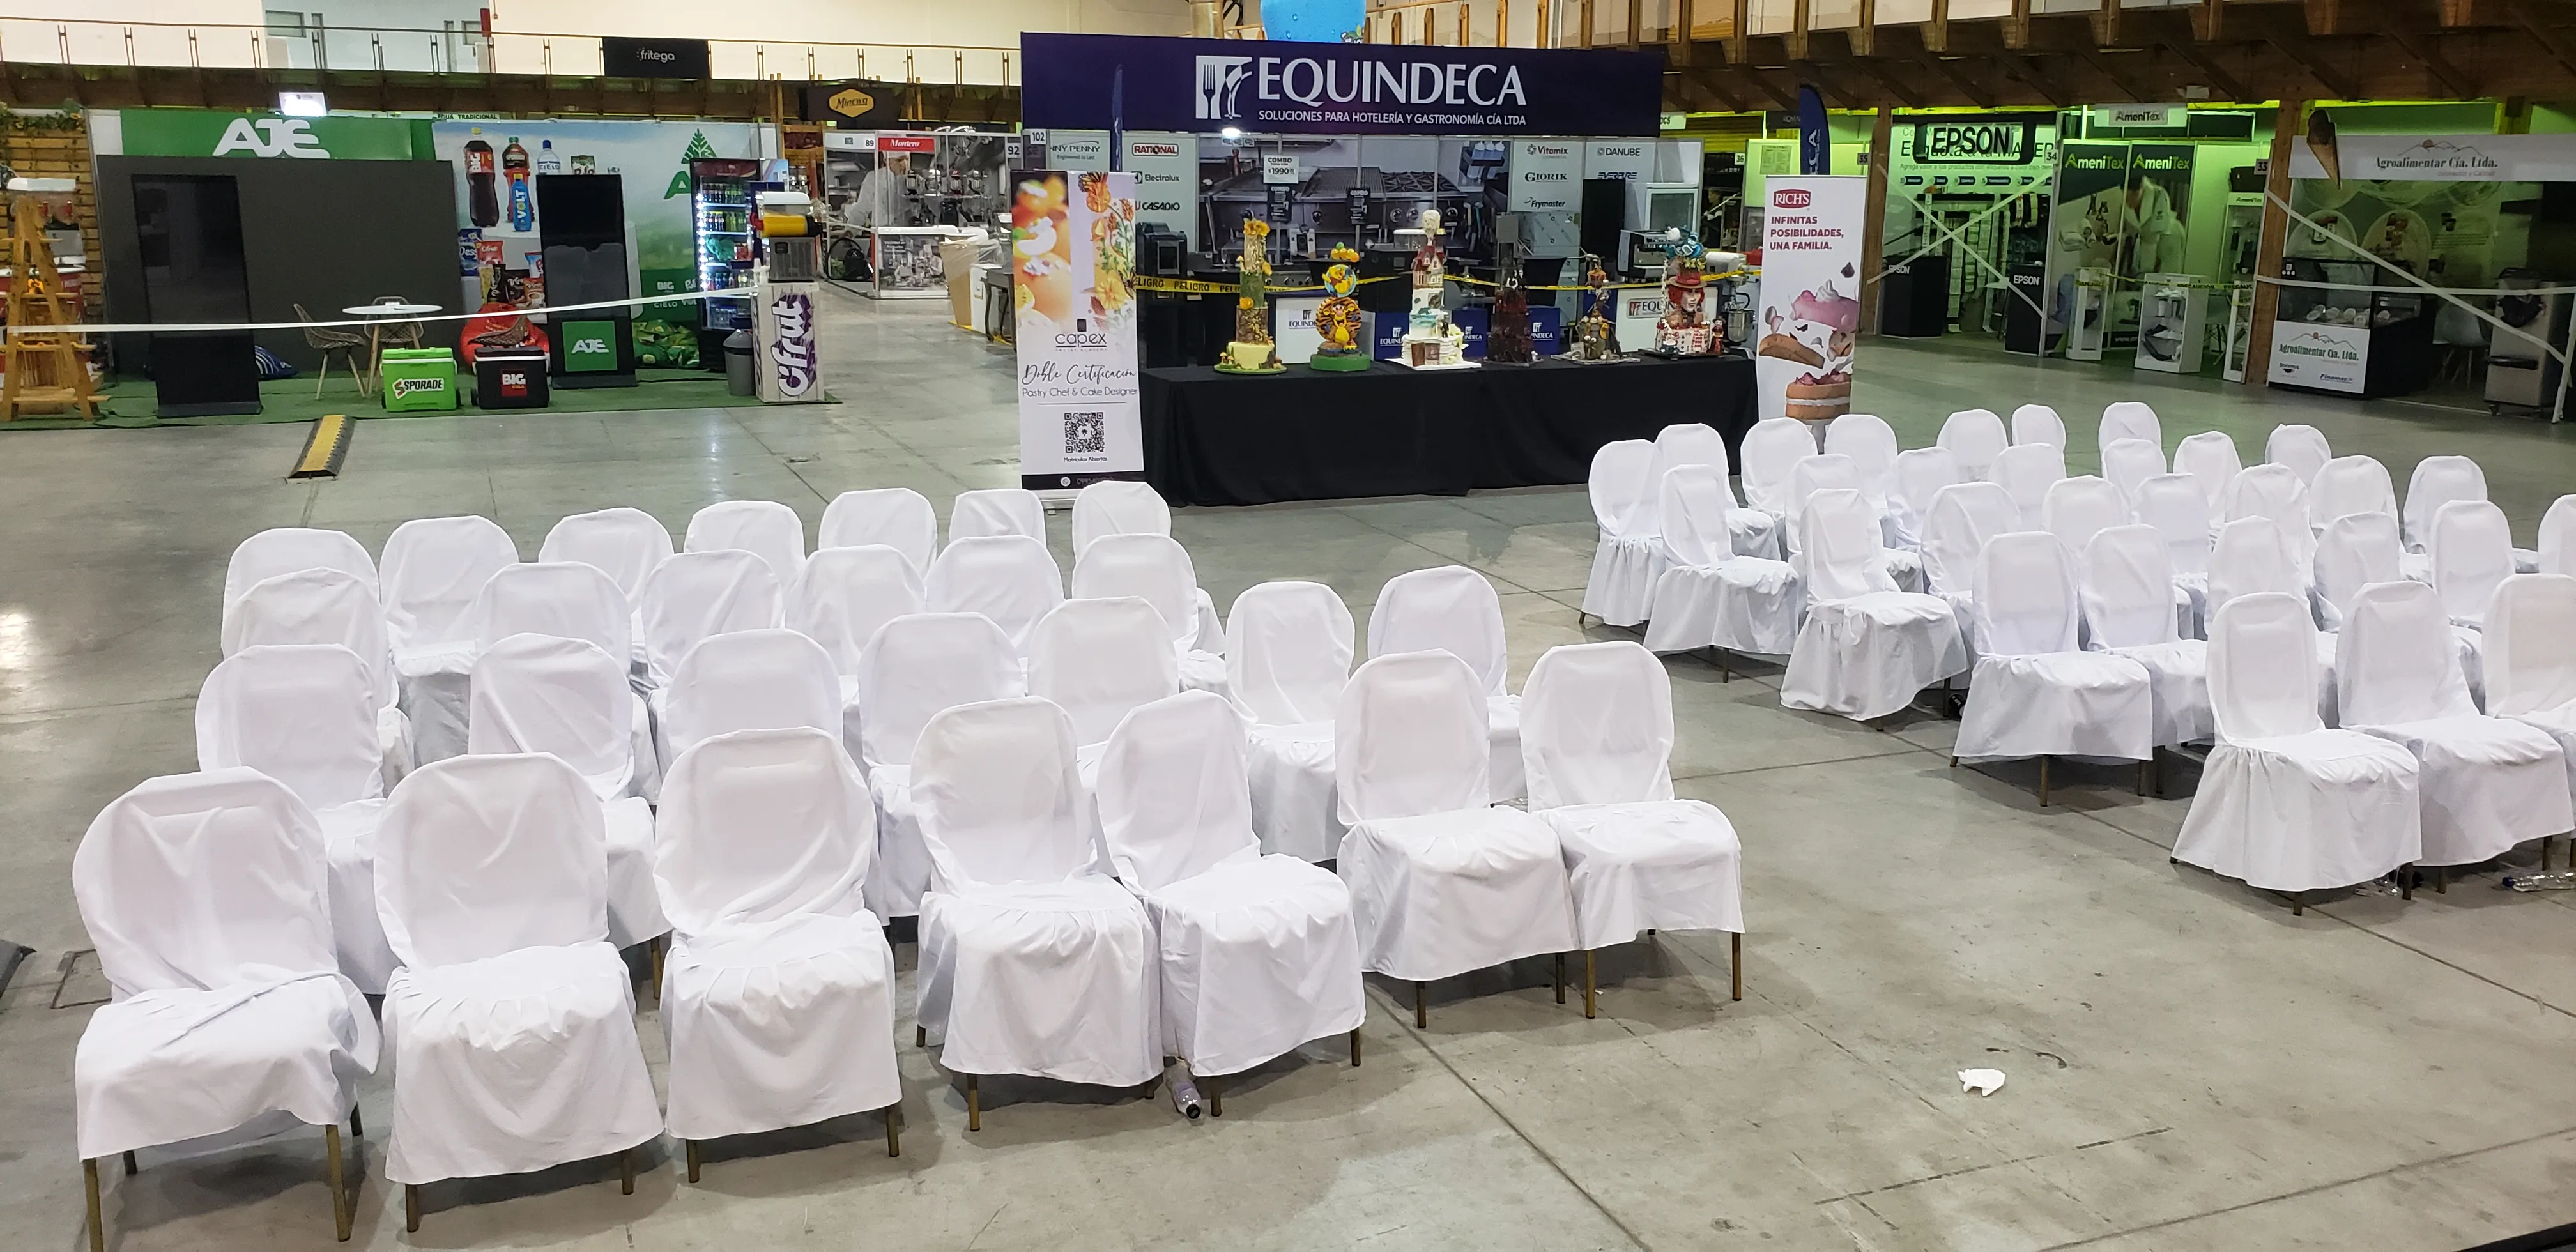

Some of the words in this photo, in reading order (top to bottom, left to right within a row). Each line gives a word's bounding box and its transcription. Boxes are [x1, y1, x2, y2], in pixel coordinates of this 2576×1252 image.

[640, 50, 675, 63] fritega
[1259, 57, 1527, 107] EQUINDECA
[1259, 110, 1322, 121] SOLUCIONES
[1324, 111, 1350, 122] PARA
[1352, 111, 1404, 123] HOTELERÍA
[1406, 113, 1413, 124] Y
[1414, 112, 1485, 125] GASTRONOMÍA
[1486, 113, 1502, 125] CÍA
[1503, 115, 1526, 125] LTDA
[2115, 111, 2161, 122] AmeniTex
[213, 118, 330, 159] AJE
[1032, 132, 1045, 142] 102
[1931, 126, 2011, 155] EPSON
[1008, 146, 1020, 155] 92
[1537, 146, 1568, 155] Vitamix
[1606, 148, 1641, 156] DANUBE
[2046, 151, 2057, 161] 34
[469, 153, 481, 172] BIG
[1736, 155, 1744, 163] 36
[1859, 155, 1868, 163] 35
[2065, 153, 2124, 169] AmeniTex
[2133, 153, 2190, 169] AmeniTex
[2258, 162, 2268, 171] 33
[1144, 174, 1180, 182] Electrolux
[515, 190, 527, 219] VOLT
[1142, 202, 1181, 211] CASADIO
[1531, 200, 1566, 209] Frymaster
[1771, 216, 1818, 225] INFINITAS
[1770, 229, 1844, 239] POSIBILIDADES,
[1770, 241, 1790, 250] UNA
[1791, 241, 1832, 250] FAMILIA.
[657, 281, 675, 290] BIG
[1174, 280, 1210, 292] PELIGRO
[2013, 275, 2040, 286] EPSON
[1055, 333, 1107, 348] capex
[571, 339, 610, 355] AJE
[1022, 360, 1062, 385] Doble
[1066, 363, 1136, 385] Certificación
[502, 374, 526, 385] BIG
[1022, 388, 1047, 398] Pastry
[1049, 387, 1070, 397] Chef
[1071, 387, 1078, 396] &
[1080, 386, 1103, 396] Cake
[1105, 386, 1137, 397] Designer
